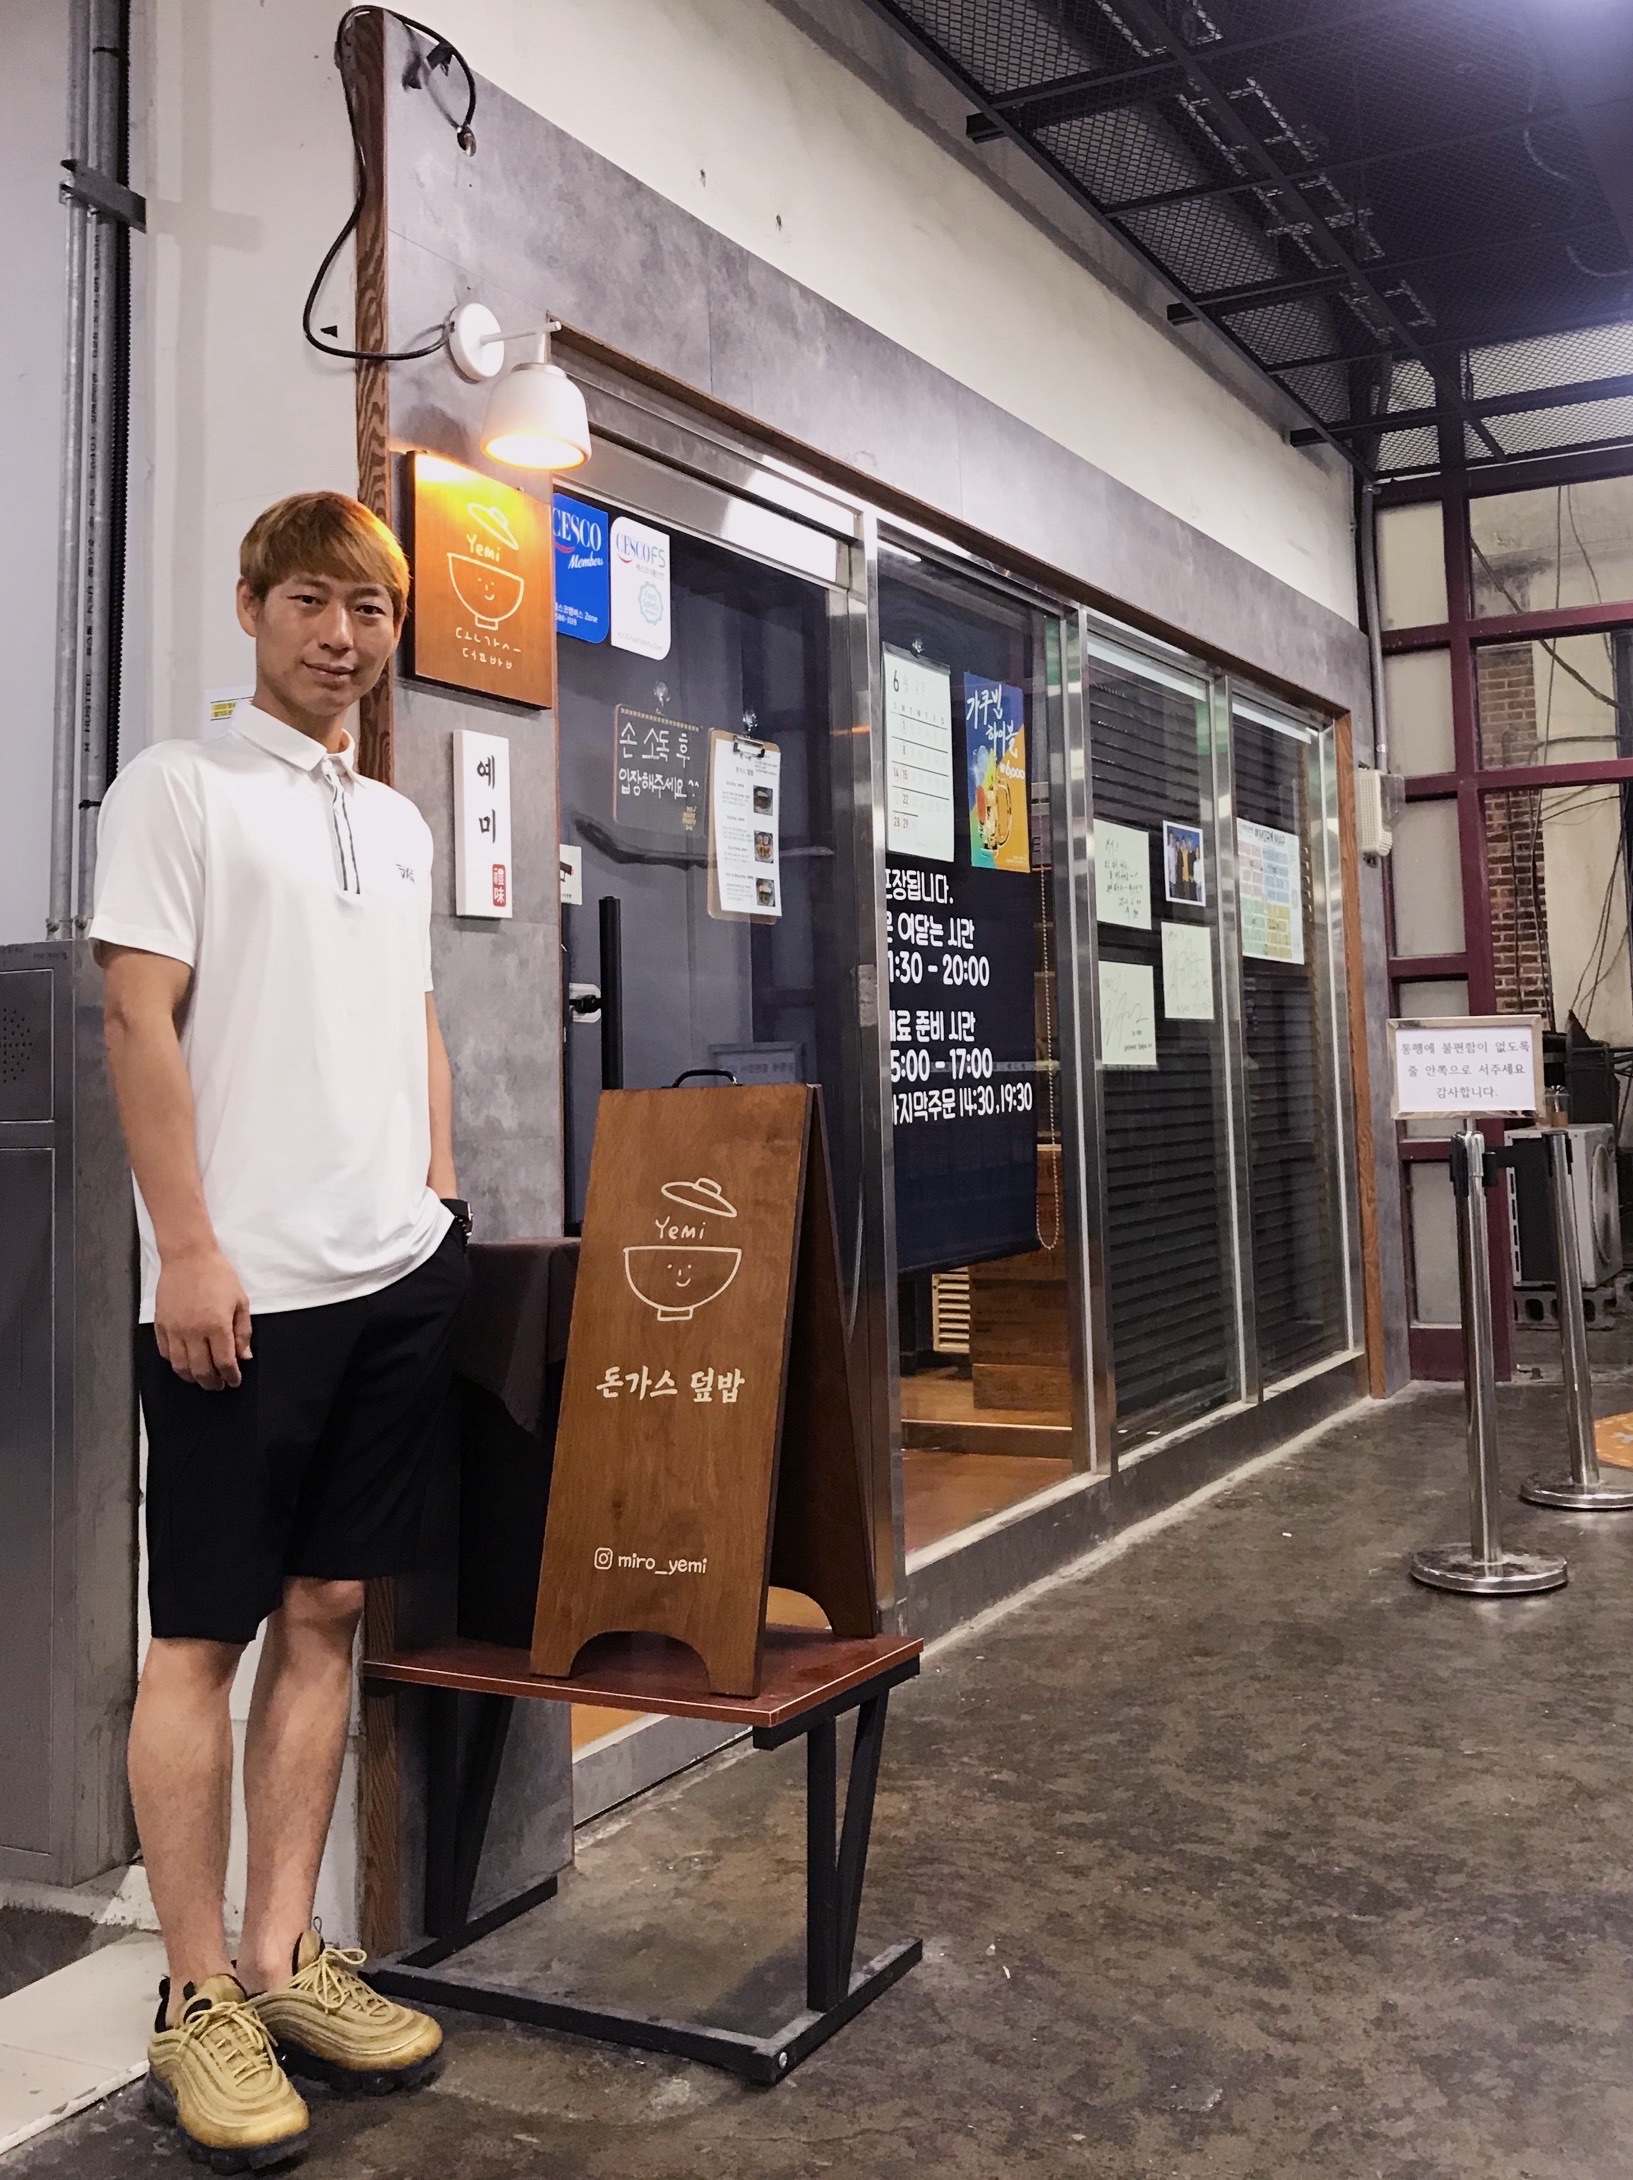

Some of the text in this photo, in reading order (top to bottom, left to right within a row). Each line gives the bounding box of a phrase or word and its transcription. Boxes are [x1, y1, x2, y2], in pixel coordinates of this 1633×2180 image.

[553, 507, 602, 552] CESCO
[466, 534, 500, 562] Yemi
[568, 551, 604, 570] Members
[584, 611, 598, 624] Zone
[893, 669, 899, 693] 6
[619, 722, 691, 768] 손 소독 후
[986, 719, 1019, 760] 하이볼
[619, 768, 687, 800] 입장해주세요
[898, 912, 944, 948] 여닫는
[948, 917, 975, 949] 시간
[942, 953, 990, 987] 20:00
[915, 1010, 945, 1043] 준비
[948, 1010, 976, 1042] 시간
[1400, 1040, 1531, 1055] 통행에 불편함이 없도록
[949, 1047, 993, 1080] 17:00
[1408, 1063, 1526, 1077] 줄 안쪽으로 서주세요
[1436, 1086, 1499, 1098] 감사합니다.
[654, 1215, 706, 1240] Yemi
[596, 1365, 745, 1403] 돈가스 덮밥
[618, 1553, 708, 1575] miro_yemi
